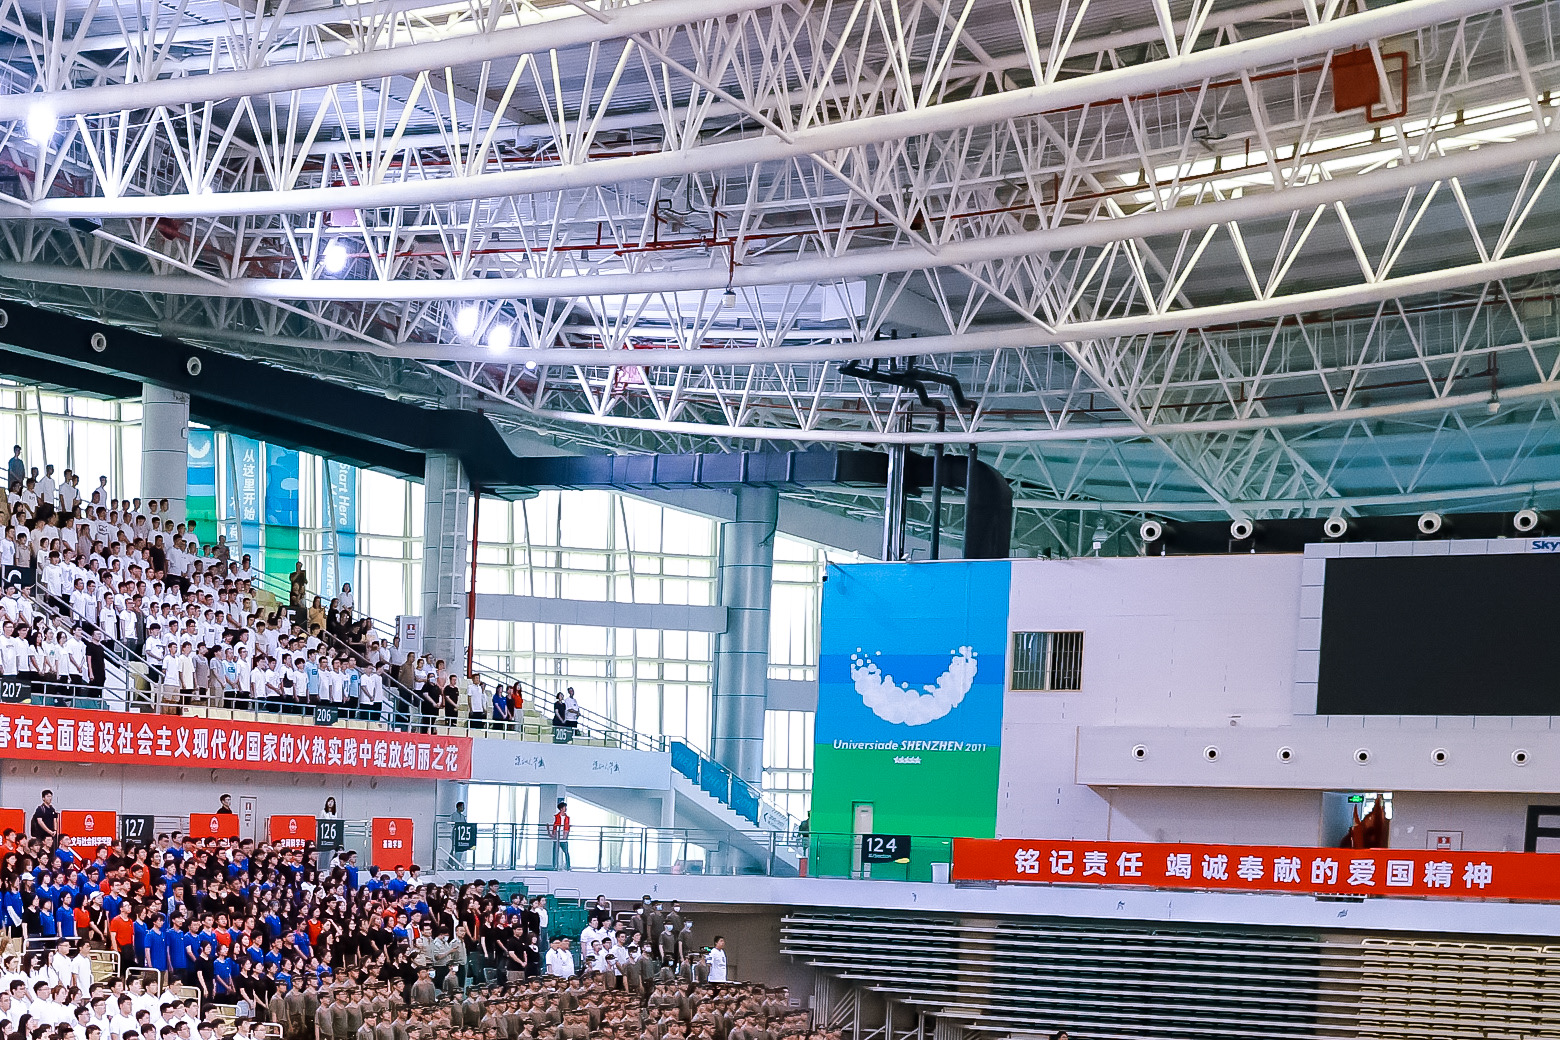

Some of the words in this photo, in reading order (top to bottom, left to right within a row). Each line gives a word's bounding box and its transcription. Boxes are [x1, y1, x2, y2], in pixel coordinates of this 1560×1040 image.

[242, 448, 256, 522] 从这里开始
[338, 494, 351, 526] Here
[1532, 540, 1560, 551] Sky
[2, 682, 22, 699] 207
[316, 707, 332, 723] 206
[555, 728, 567, 741] 205
[833, 739, 899, 751] Universiade
[900, 740, 964, 752] SHENZHEN
[965, 743, 987, 753] 2011
[125, 818, 145, 837] 127
[320, 823, 337, 840] 126
[458, 825, 471, 841] 125
[866, 837, 898, 853] 124
[1014, 848, 1144, 878] 铭记责任
[1165, 852, 1493, 889] 竭诚奉献的爱国精神
